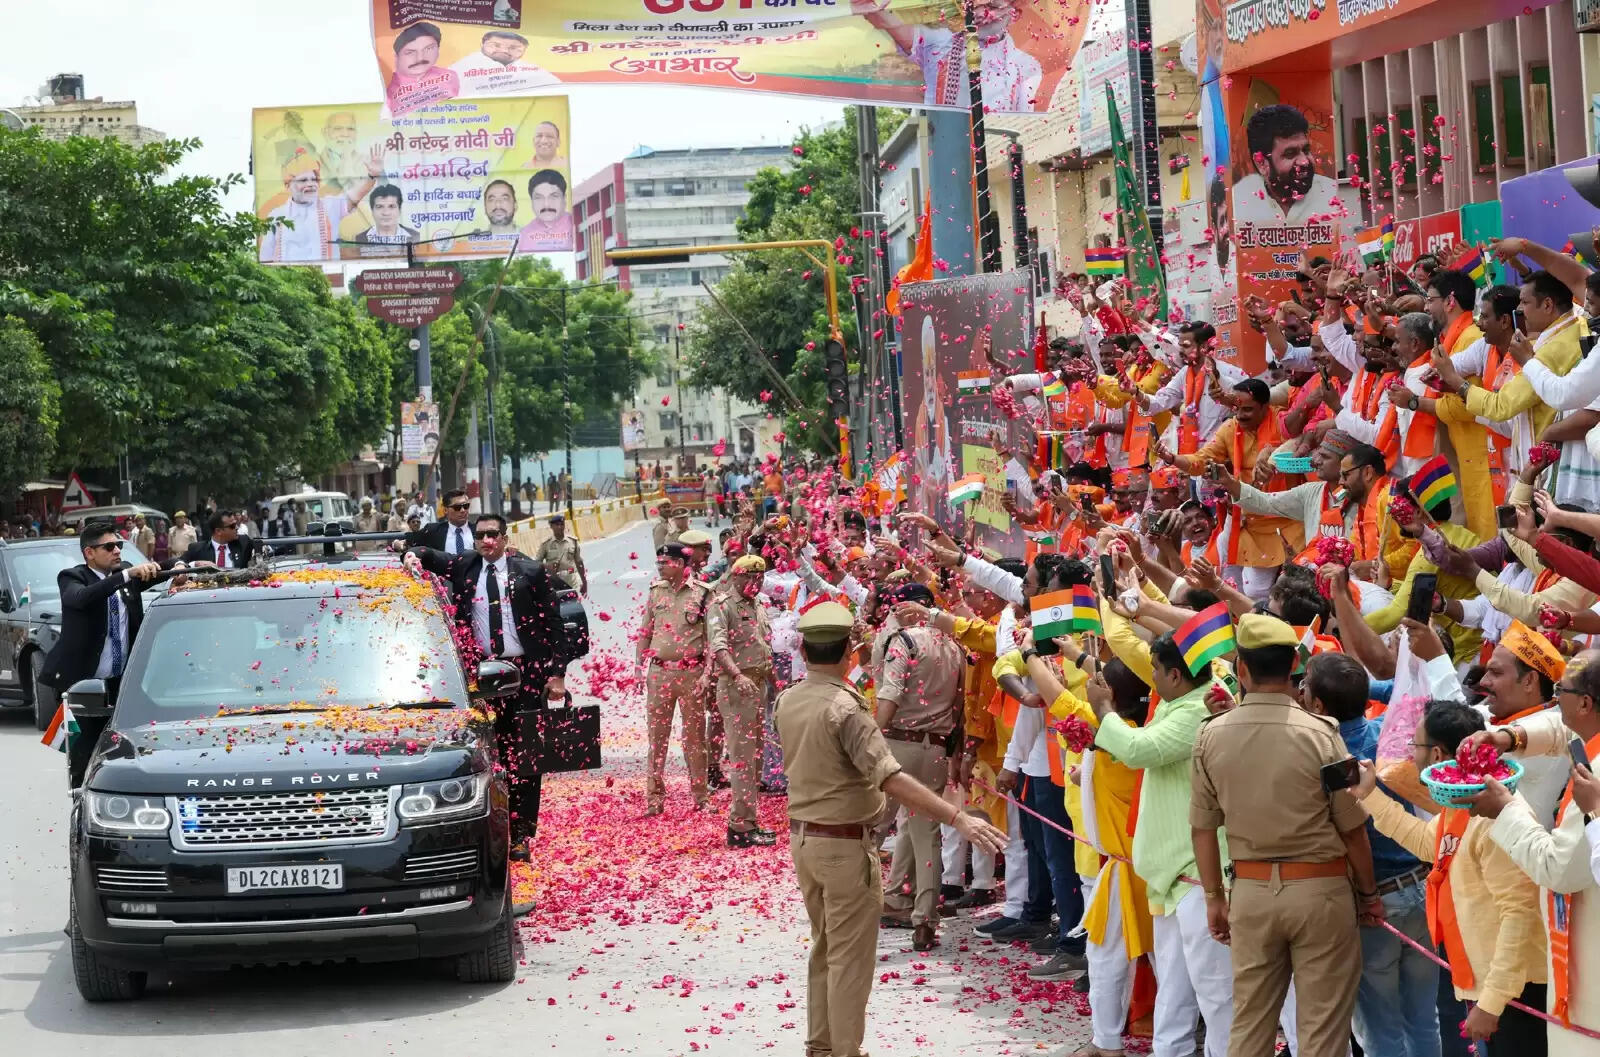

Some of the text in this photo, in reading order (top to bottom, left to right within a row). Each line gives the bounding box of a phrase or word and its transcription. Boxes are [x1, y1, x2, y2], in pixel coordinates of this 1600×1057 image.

[573, 22, 609, 31] मिला
[643, 23, 665, 31] को
[668, 20, 728, 32] दीपावली
[732, 23, 753, 31] का
[551, 41, 589, 53] श्री
[609, 56, 755, 82] आभार
[386, 128, 515, 151] श्री नरेन्द्र मोदी जी
[403, 157, 488, 179] जन्मदिन
[407, 187, 482, 201] की हार्दिक बधाई
[1240, 221, 1332, 247] डॉ. दयाशंकर मिश्र
[380, 270, 394, 279] DEVI
[381, 297, 440, 308] SANSKRIT UNIVERSITY
[187, 772, 379, 787] RANGE ROVER
[240, 868, 339, 888] DL2CAX8121
